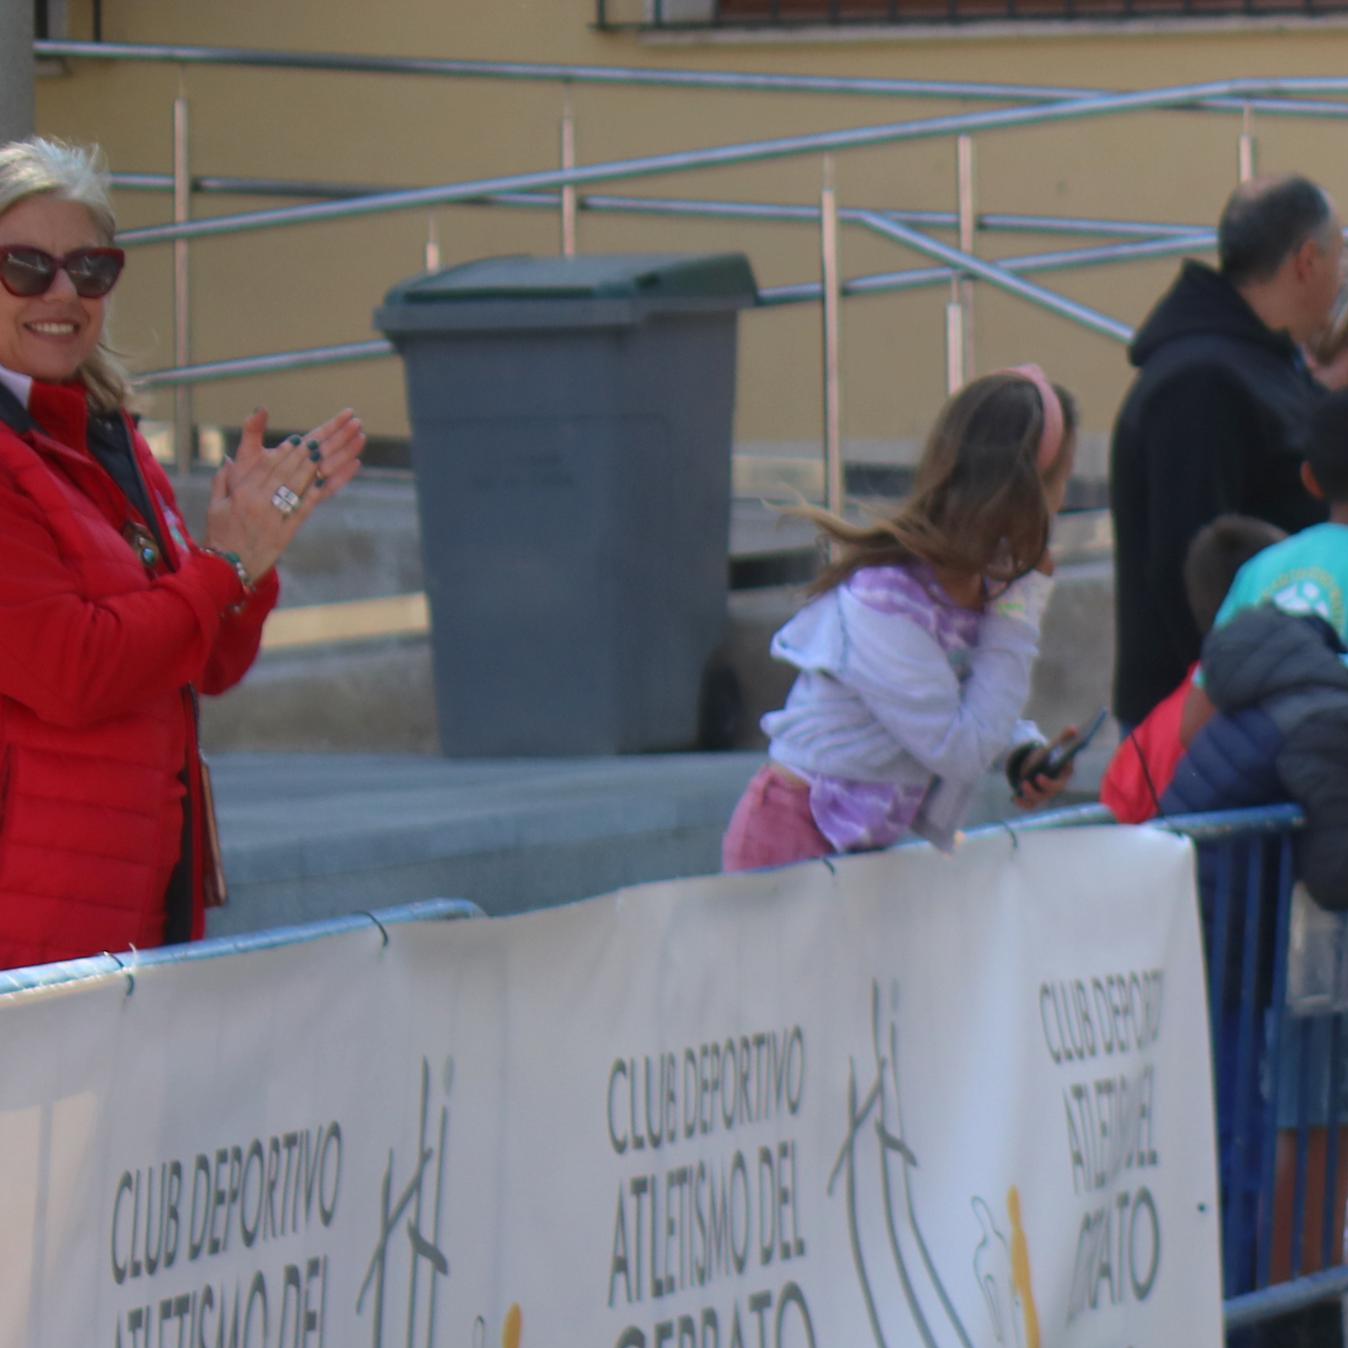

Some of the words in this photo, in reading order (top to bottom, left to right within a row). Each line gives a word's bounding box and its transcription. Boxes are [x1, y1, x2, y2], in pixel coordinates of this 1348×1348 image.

[607, 1045, 678, 1154] CLUB
[683, 1024, 803, 1131] DEPORTIVO
[110, 1162, 181, 1286] CLUB
[189, 1121, 344, 1255] DEPORTIVO
[608, 1154, 751, 1309] ATLETISMO
[759, 1139, 806, 1262] DEL
